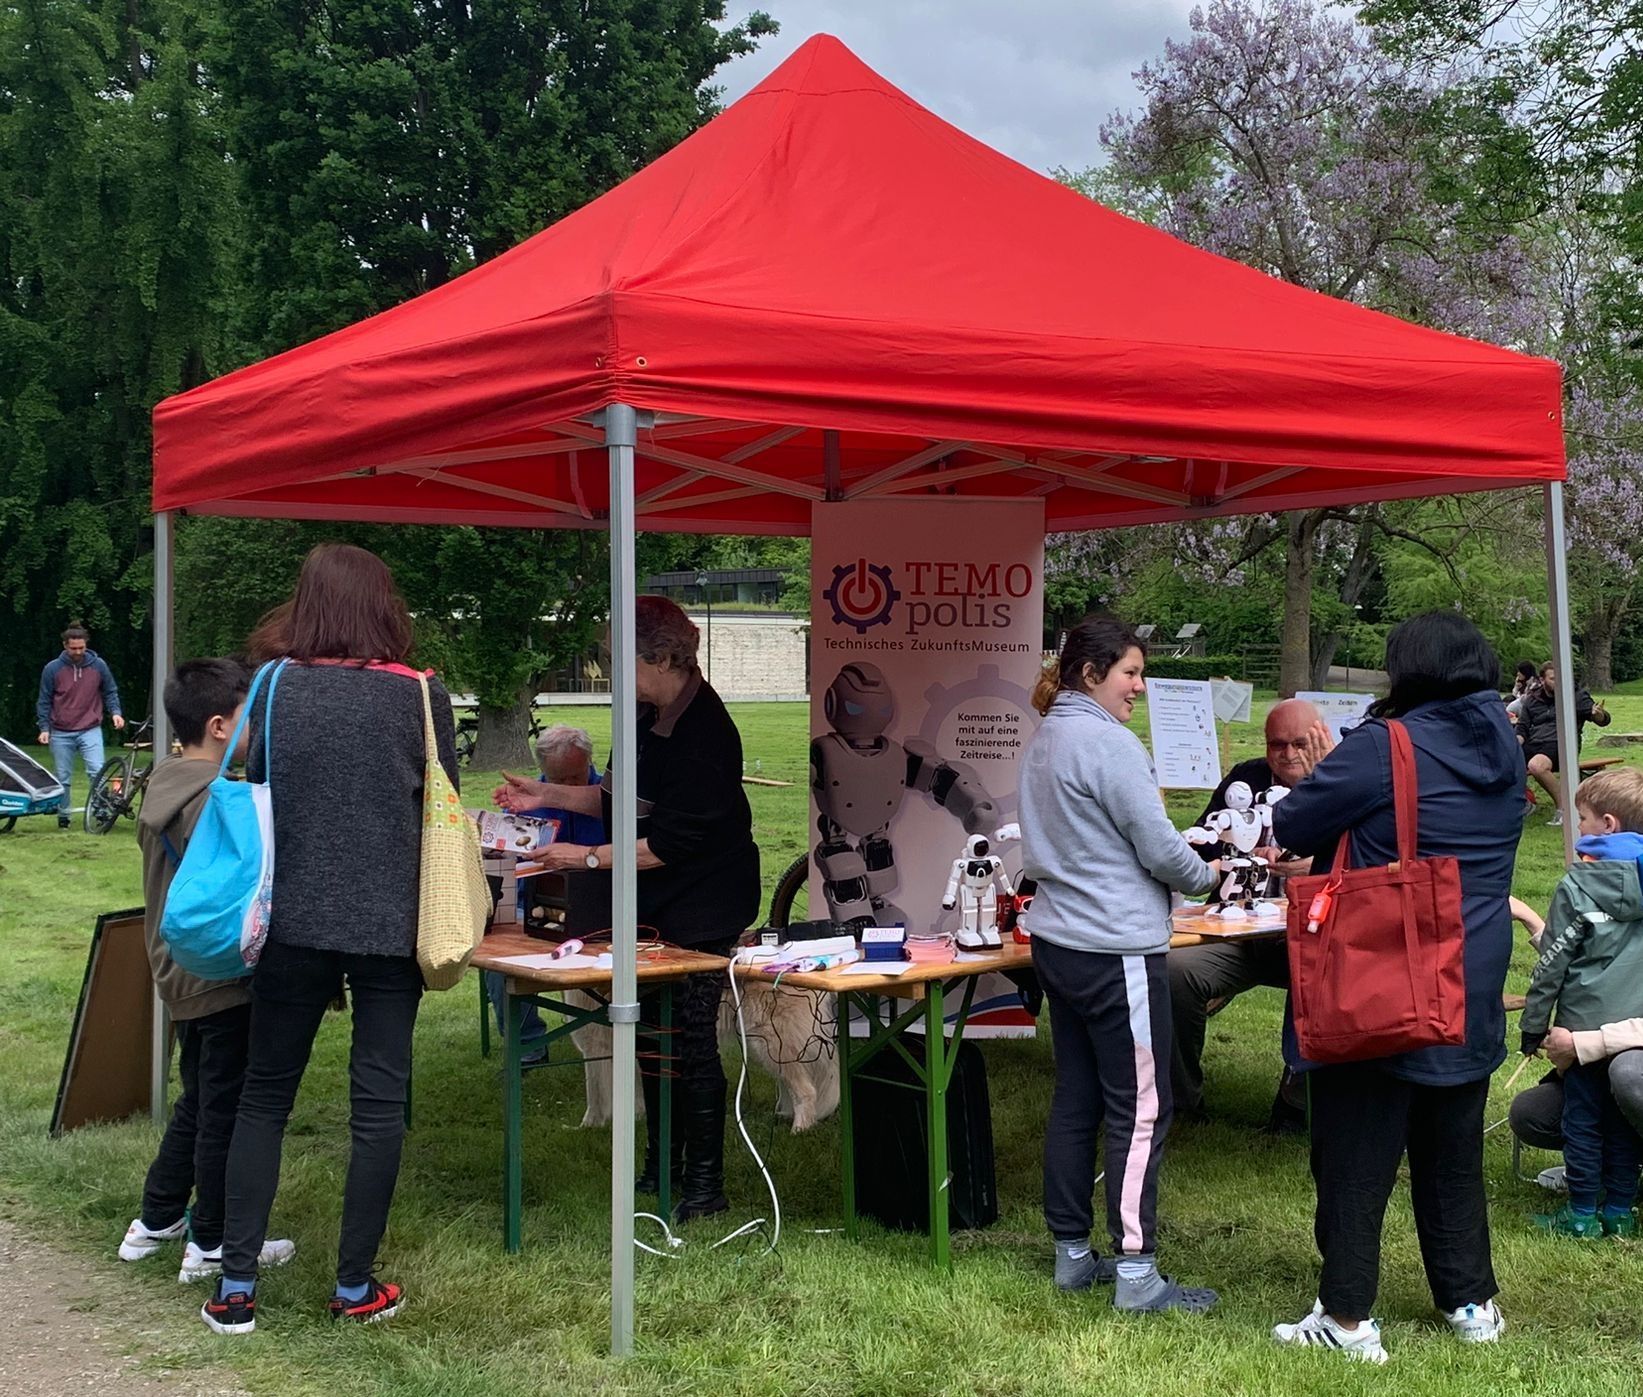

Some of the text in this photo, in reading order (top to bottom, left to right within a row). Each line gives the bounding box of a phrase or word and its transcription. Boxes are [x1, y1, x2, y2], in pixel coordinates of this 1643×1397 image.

[905, 562, 1033, 598] TEMO
[904, 593, 1011, 635] polis
[824, 637, 1030, 653] Technisches ZukunftsMuseum
[957, 712, 1020, 723] Kommen Sie
[958, 725, 1019, 736] mit auf eine
[954, 738, 1022, 748] faszinierende
